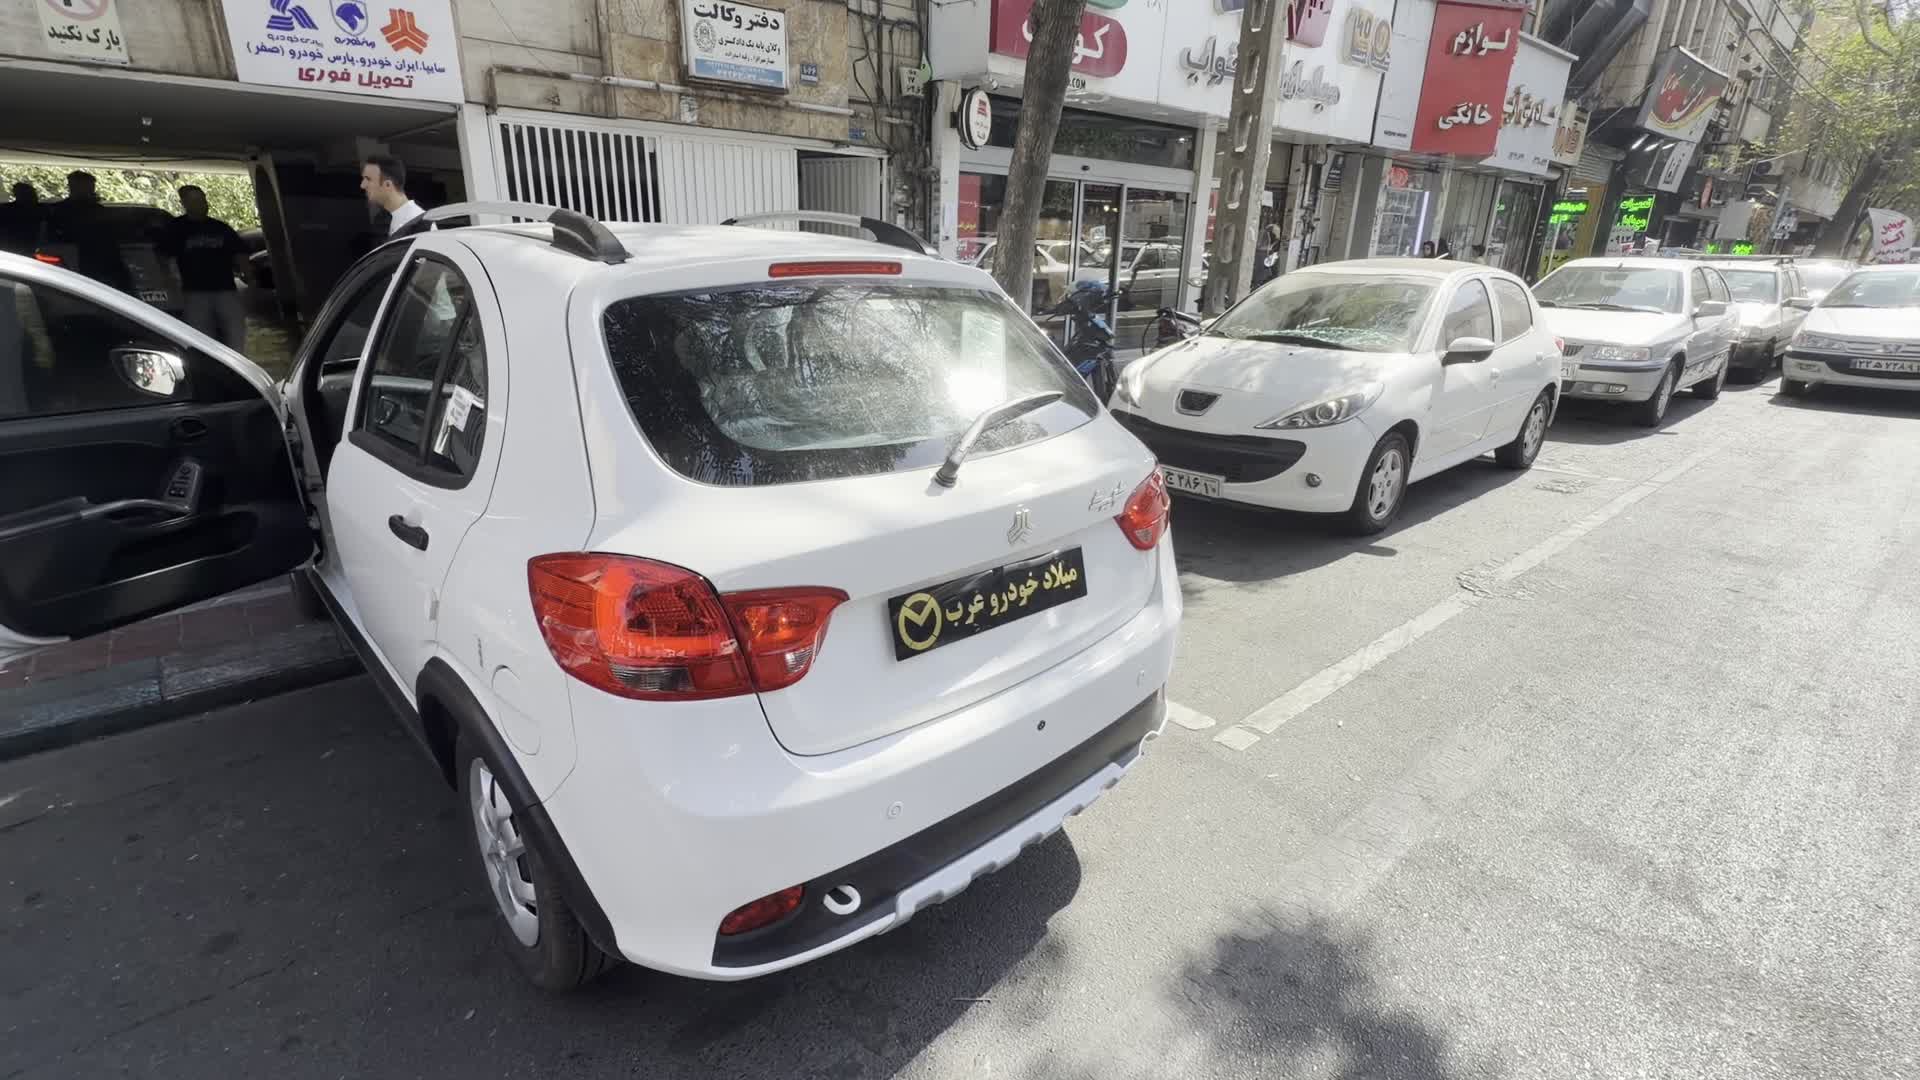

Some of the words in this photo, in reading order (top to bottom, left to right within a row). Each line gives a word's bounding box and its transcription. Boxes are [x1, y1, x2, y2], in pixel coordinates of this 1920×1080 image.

[693, 3, 742, 29] وکالت
[744, 12, 780, 31] دفتر
[48, 24, 82, 44] نکنید
[1454, 21, 1511, 56] لوازم
[288, 49, 324, 62] خودرو
[298, 66, 352, 83] فوری
[358, 70, 414, 89] تحویل
[1438, 102, 1493, 130] خانگی
[1042, 561, 1078, 590] میلاد
[990, 571, 1039, 617] خودرو
[945, 590, 985, 627] غرب
